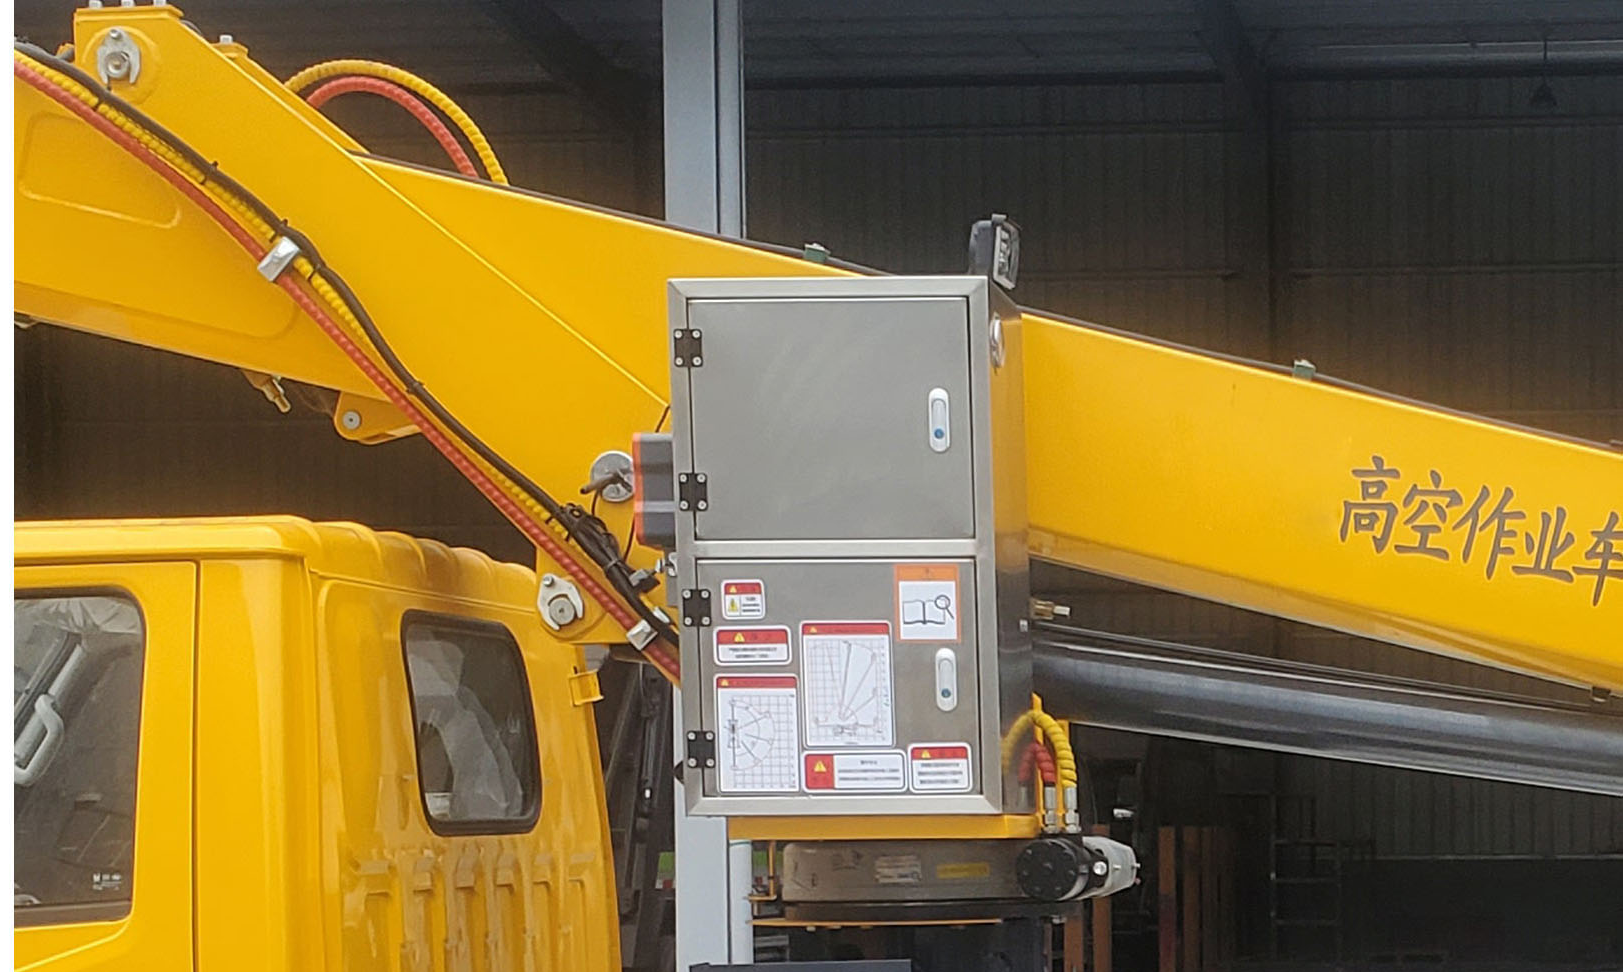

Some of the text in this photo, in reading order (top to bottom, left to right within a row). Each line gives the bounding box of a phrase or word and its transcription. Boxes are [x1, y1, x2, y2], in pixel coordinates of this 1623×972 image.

[1339, 455, 1623, 606] 高空作业车
